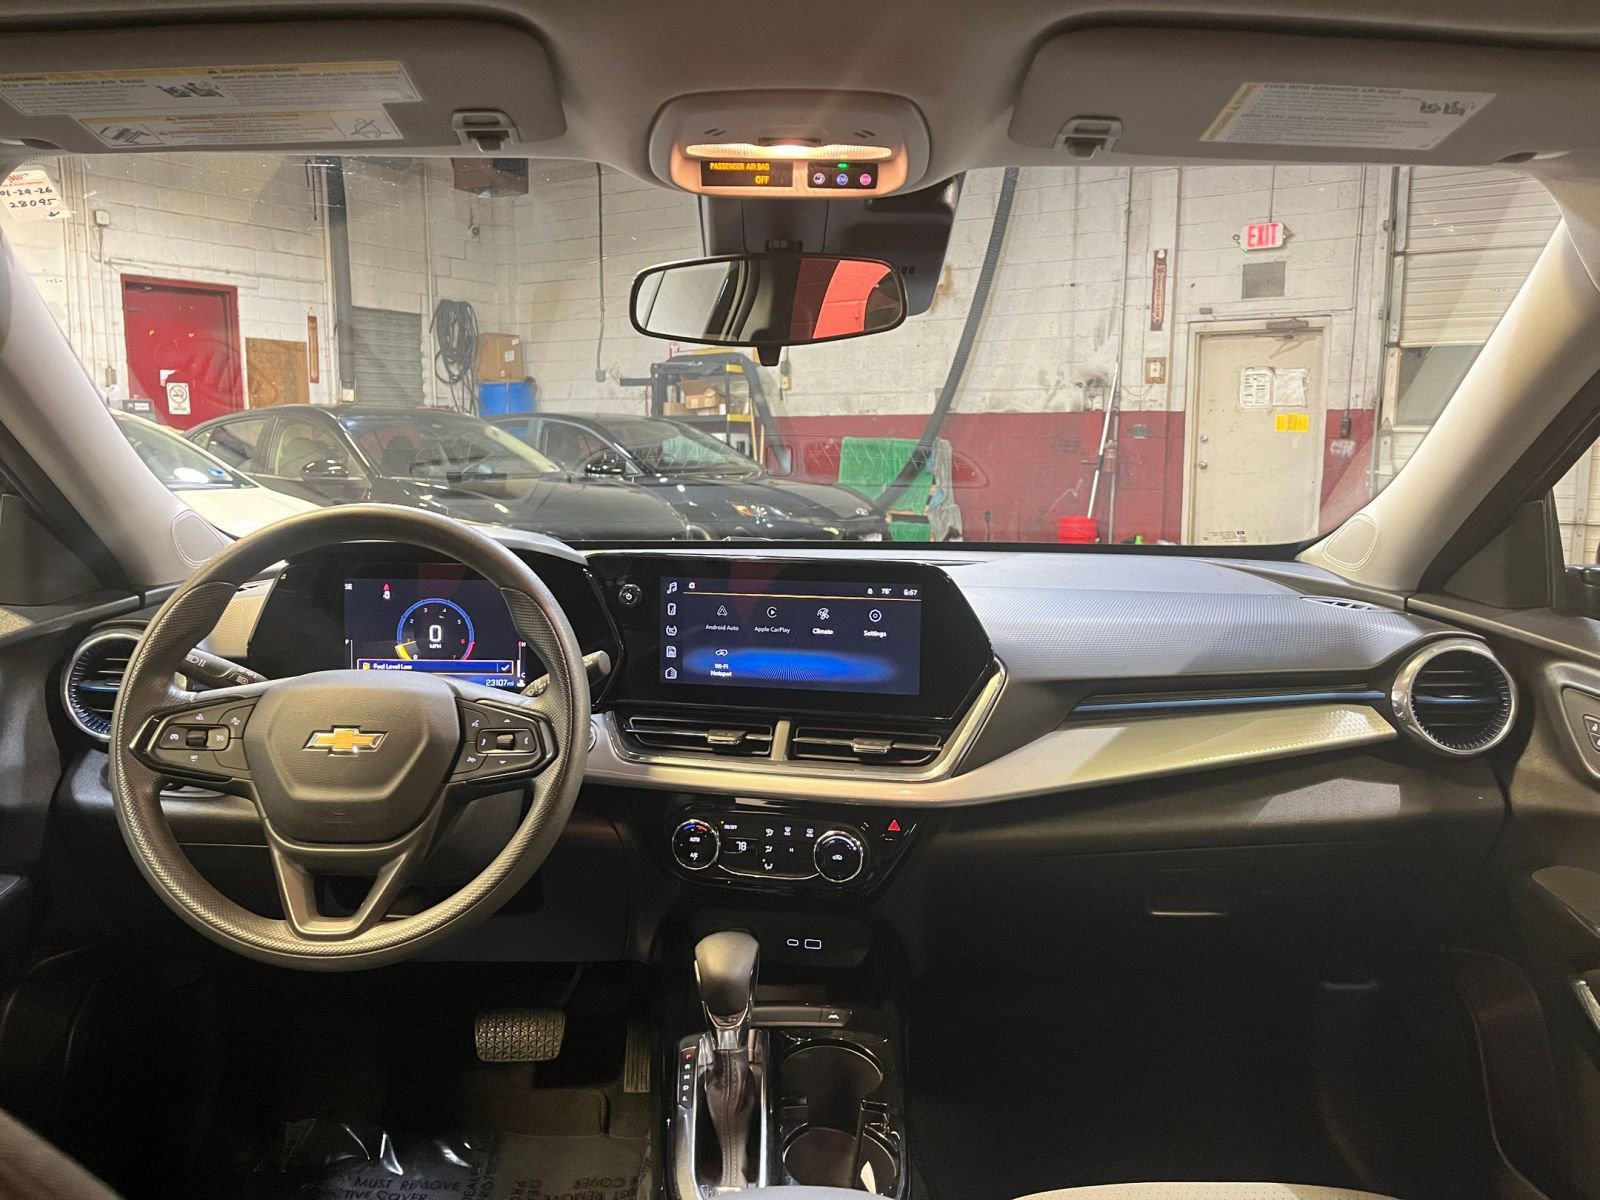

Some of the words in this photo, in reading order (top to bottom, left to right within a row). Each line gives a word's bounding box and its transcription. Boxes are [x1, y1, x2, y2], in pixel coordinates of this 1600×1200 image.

[709, 162, 745, 172] PASSENGER
[746, 162, 757, 172] AIR
[757, 163, 770, 172] BAG
[755, 175, 770, 185] OFF
[9, 198, 57, 208] 28095
[1247, 223, 1279, 248] EXIT
[705, 623, 727, 632] Android
[754, 626, 769, 634] Apple
[770, 627, 790, 635] CarPlay
[812, 627, 834, 635] Climate
[429, 624, 442, 643] 0
[863, 630, 887, 639] Settings
[710, 670, 732, 678] Hotspot
[354, 1176, 395, 1189] MUST
[399, 1178, 461, 1190] REMOVE
[573, 1177, 626, 1189] COVER
